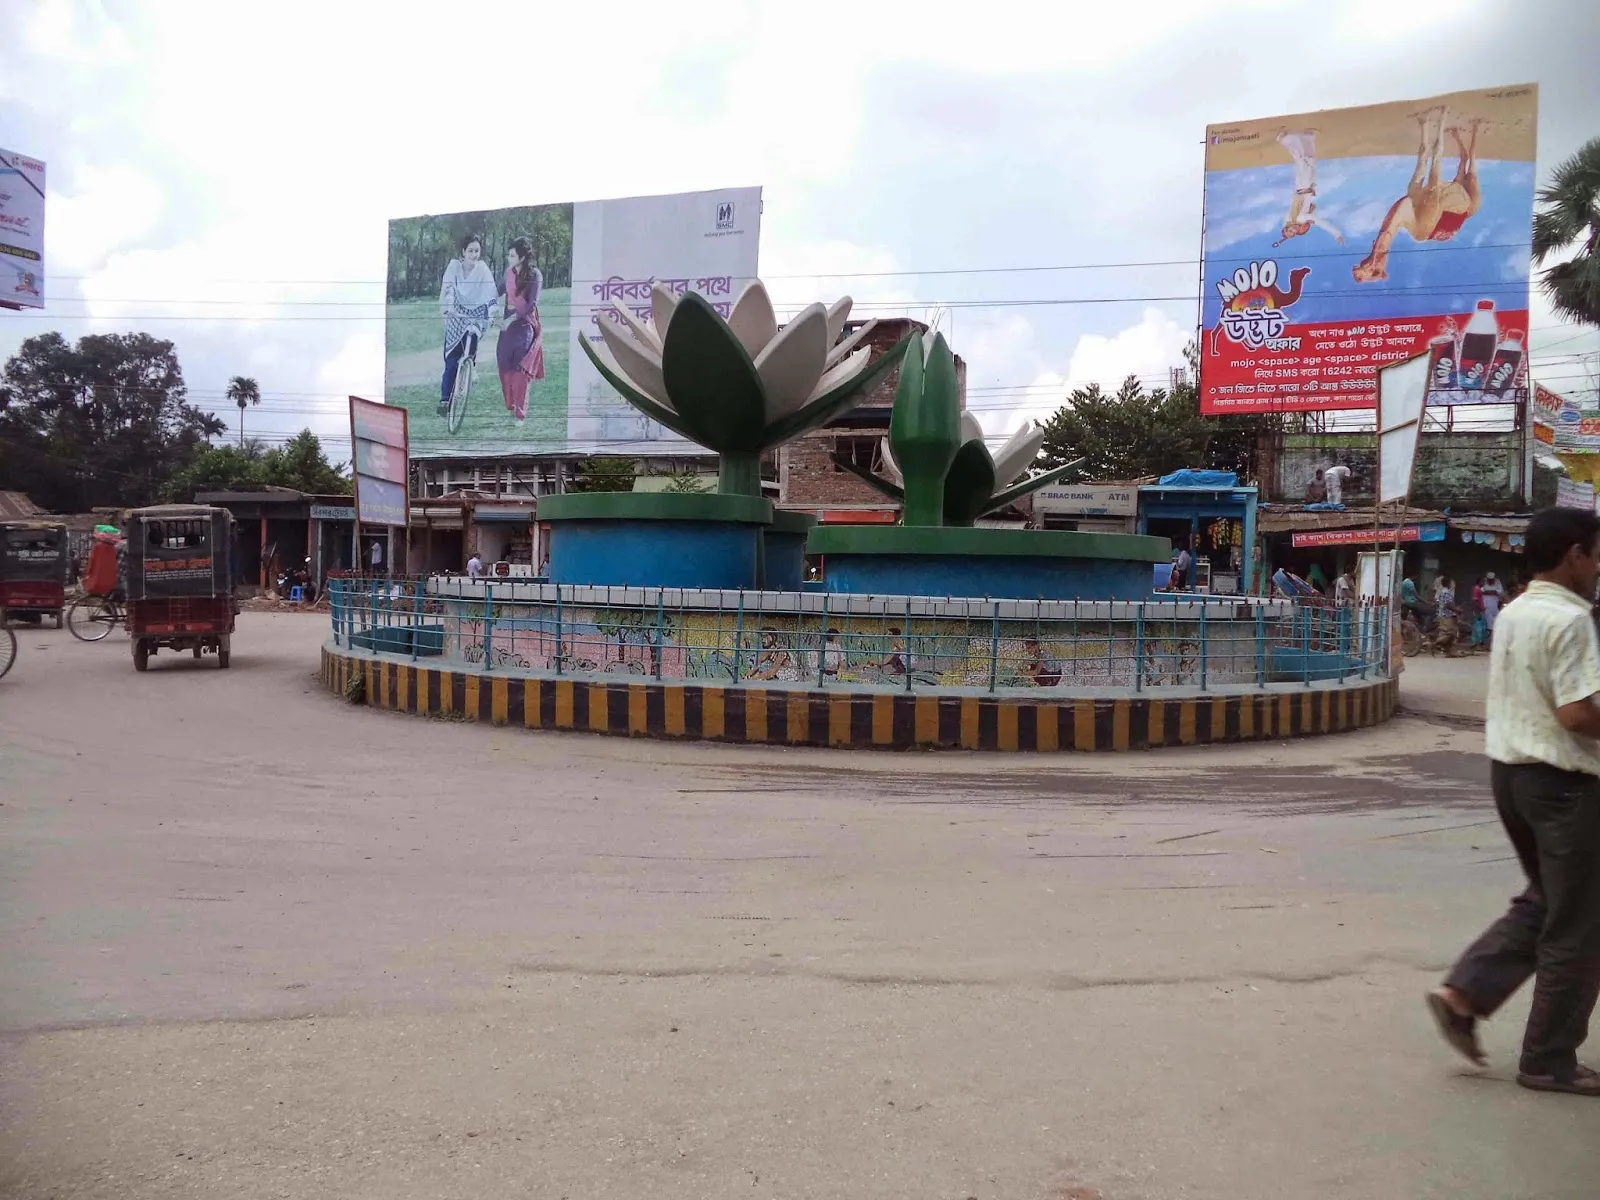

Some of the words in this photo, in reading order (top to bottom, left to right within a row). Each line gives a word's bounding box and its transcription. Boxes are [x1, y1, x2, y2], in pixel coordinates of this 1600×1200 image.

[696, 276, 732, 296] পথে
[1308, 329, 1327, 338] অংশ
[1329, 328, 1344, 337] নাও
[1264, 337, 1302, 351] অফার
[1231, 359, 1255, 369] mojo
[1258, 356, 1300, 367] <space>
[1303, 356, 1322, 365] age
[1324, 353, 1368, 364] <space>
[1371, 350, 1409, 361] district
[1275, 368, 1298, 377] SMS
[1322, 366, 1352, 376] 16242
[1218, 386, 1233, 394] জন
[1235, 383, 1255, 394] জিতে
[1257, 382, 1276, 393] নিতে
[1108, 493, 1130, 501] ATM
